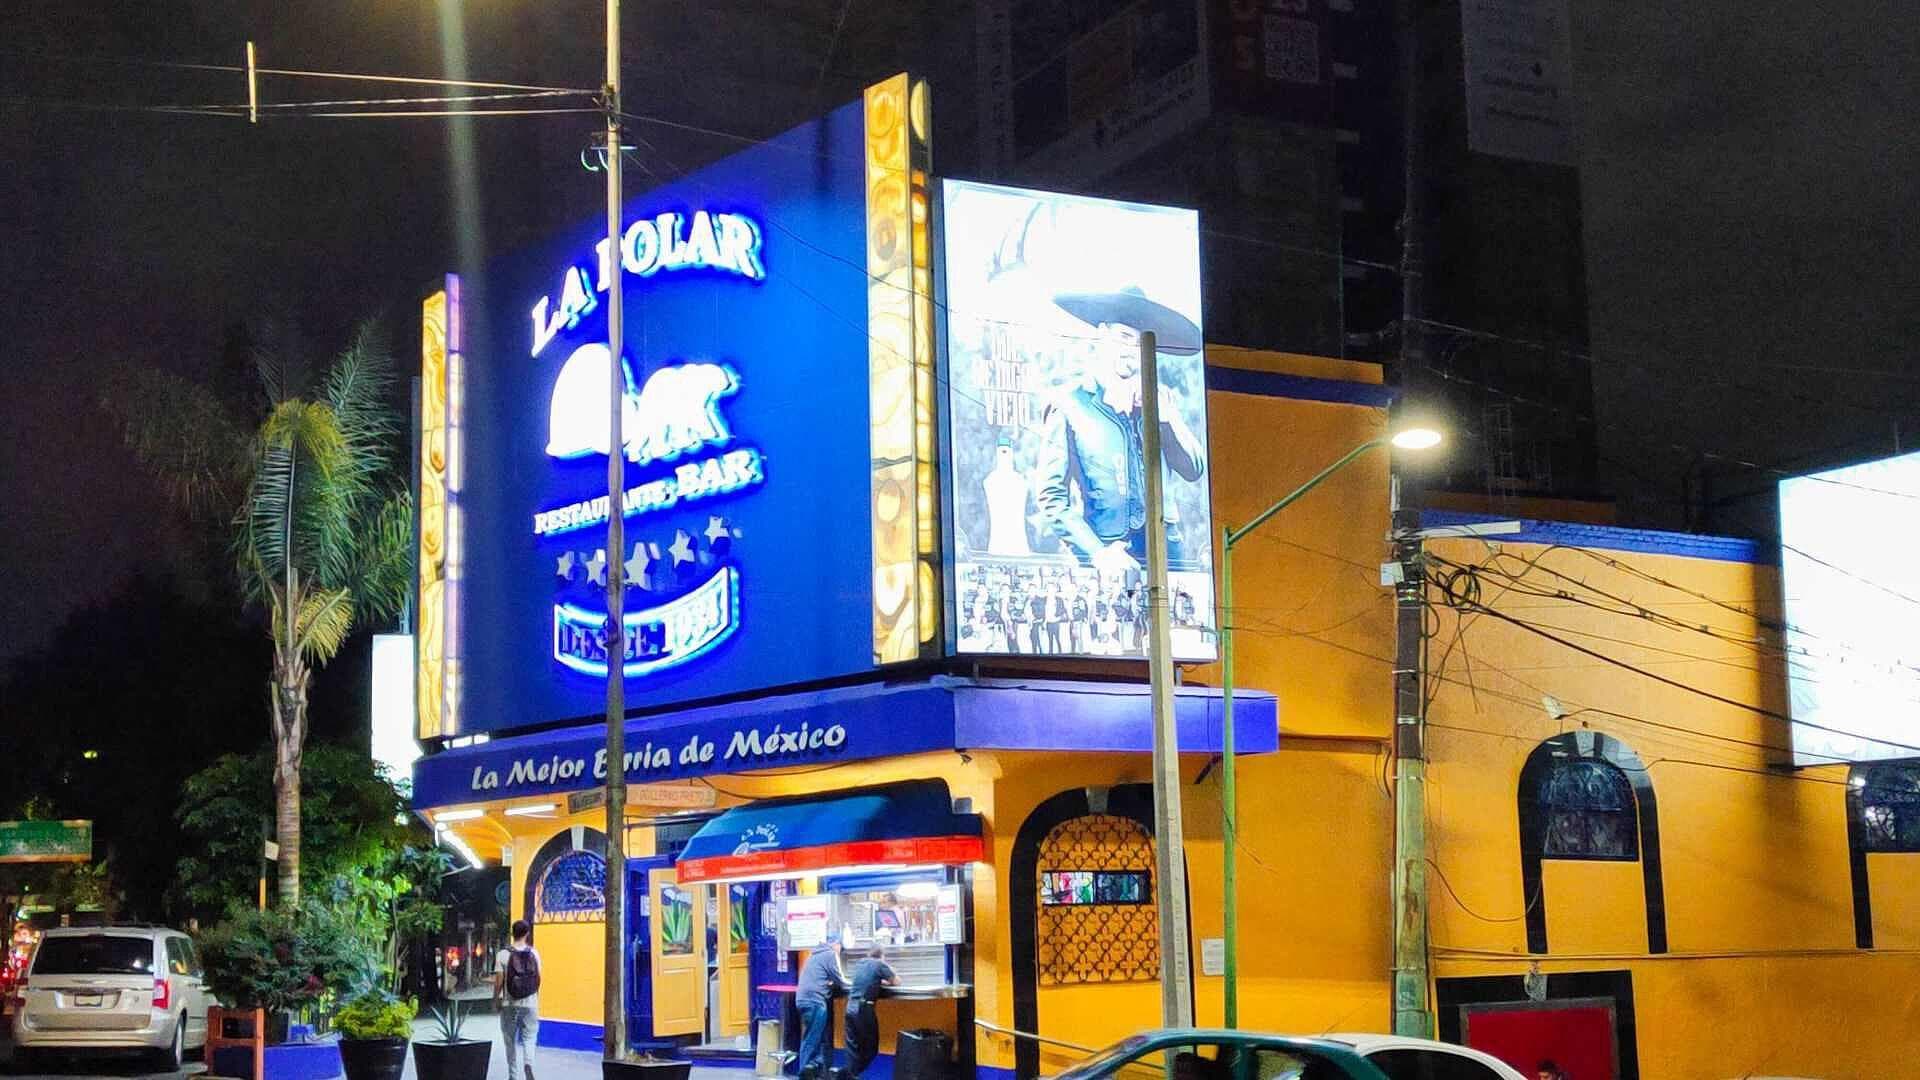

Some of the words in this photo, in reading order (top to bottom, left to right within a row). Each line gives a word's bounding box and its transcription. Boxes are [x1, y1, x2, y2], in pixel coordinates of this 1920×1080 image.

[532, 265, 595, 358] LA
[675, 449, 760, 498] BAR
[472, 765, 498, 790] La
[505, 756, 585, 787] Mejor
[593, 742, 671, 779] Brria
[679, 735, 714, 767] de
[723, 722, 846, 760] México
